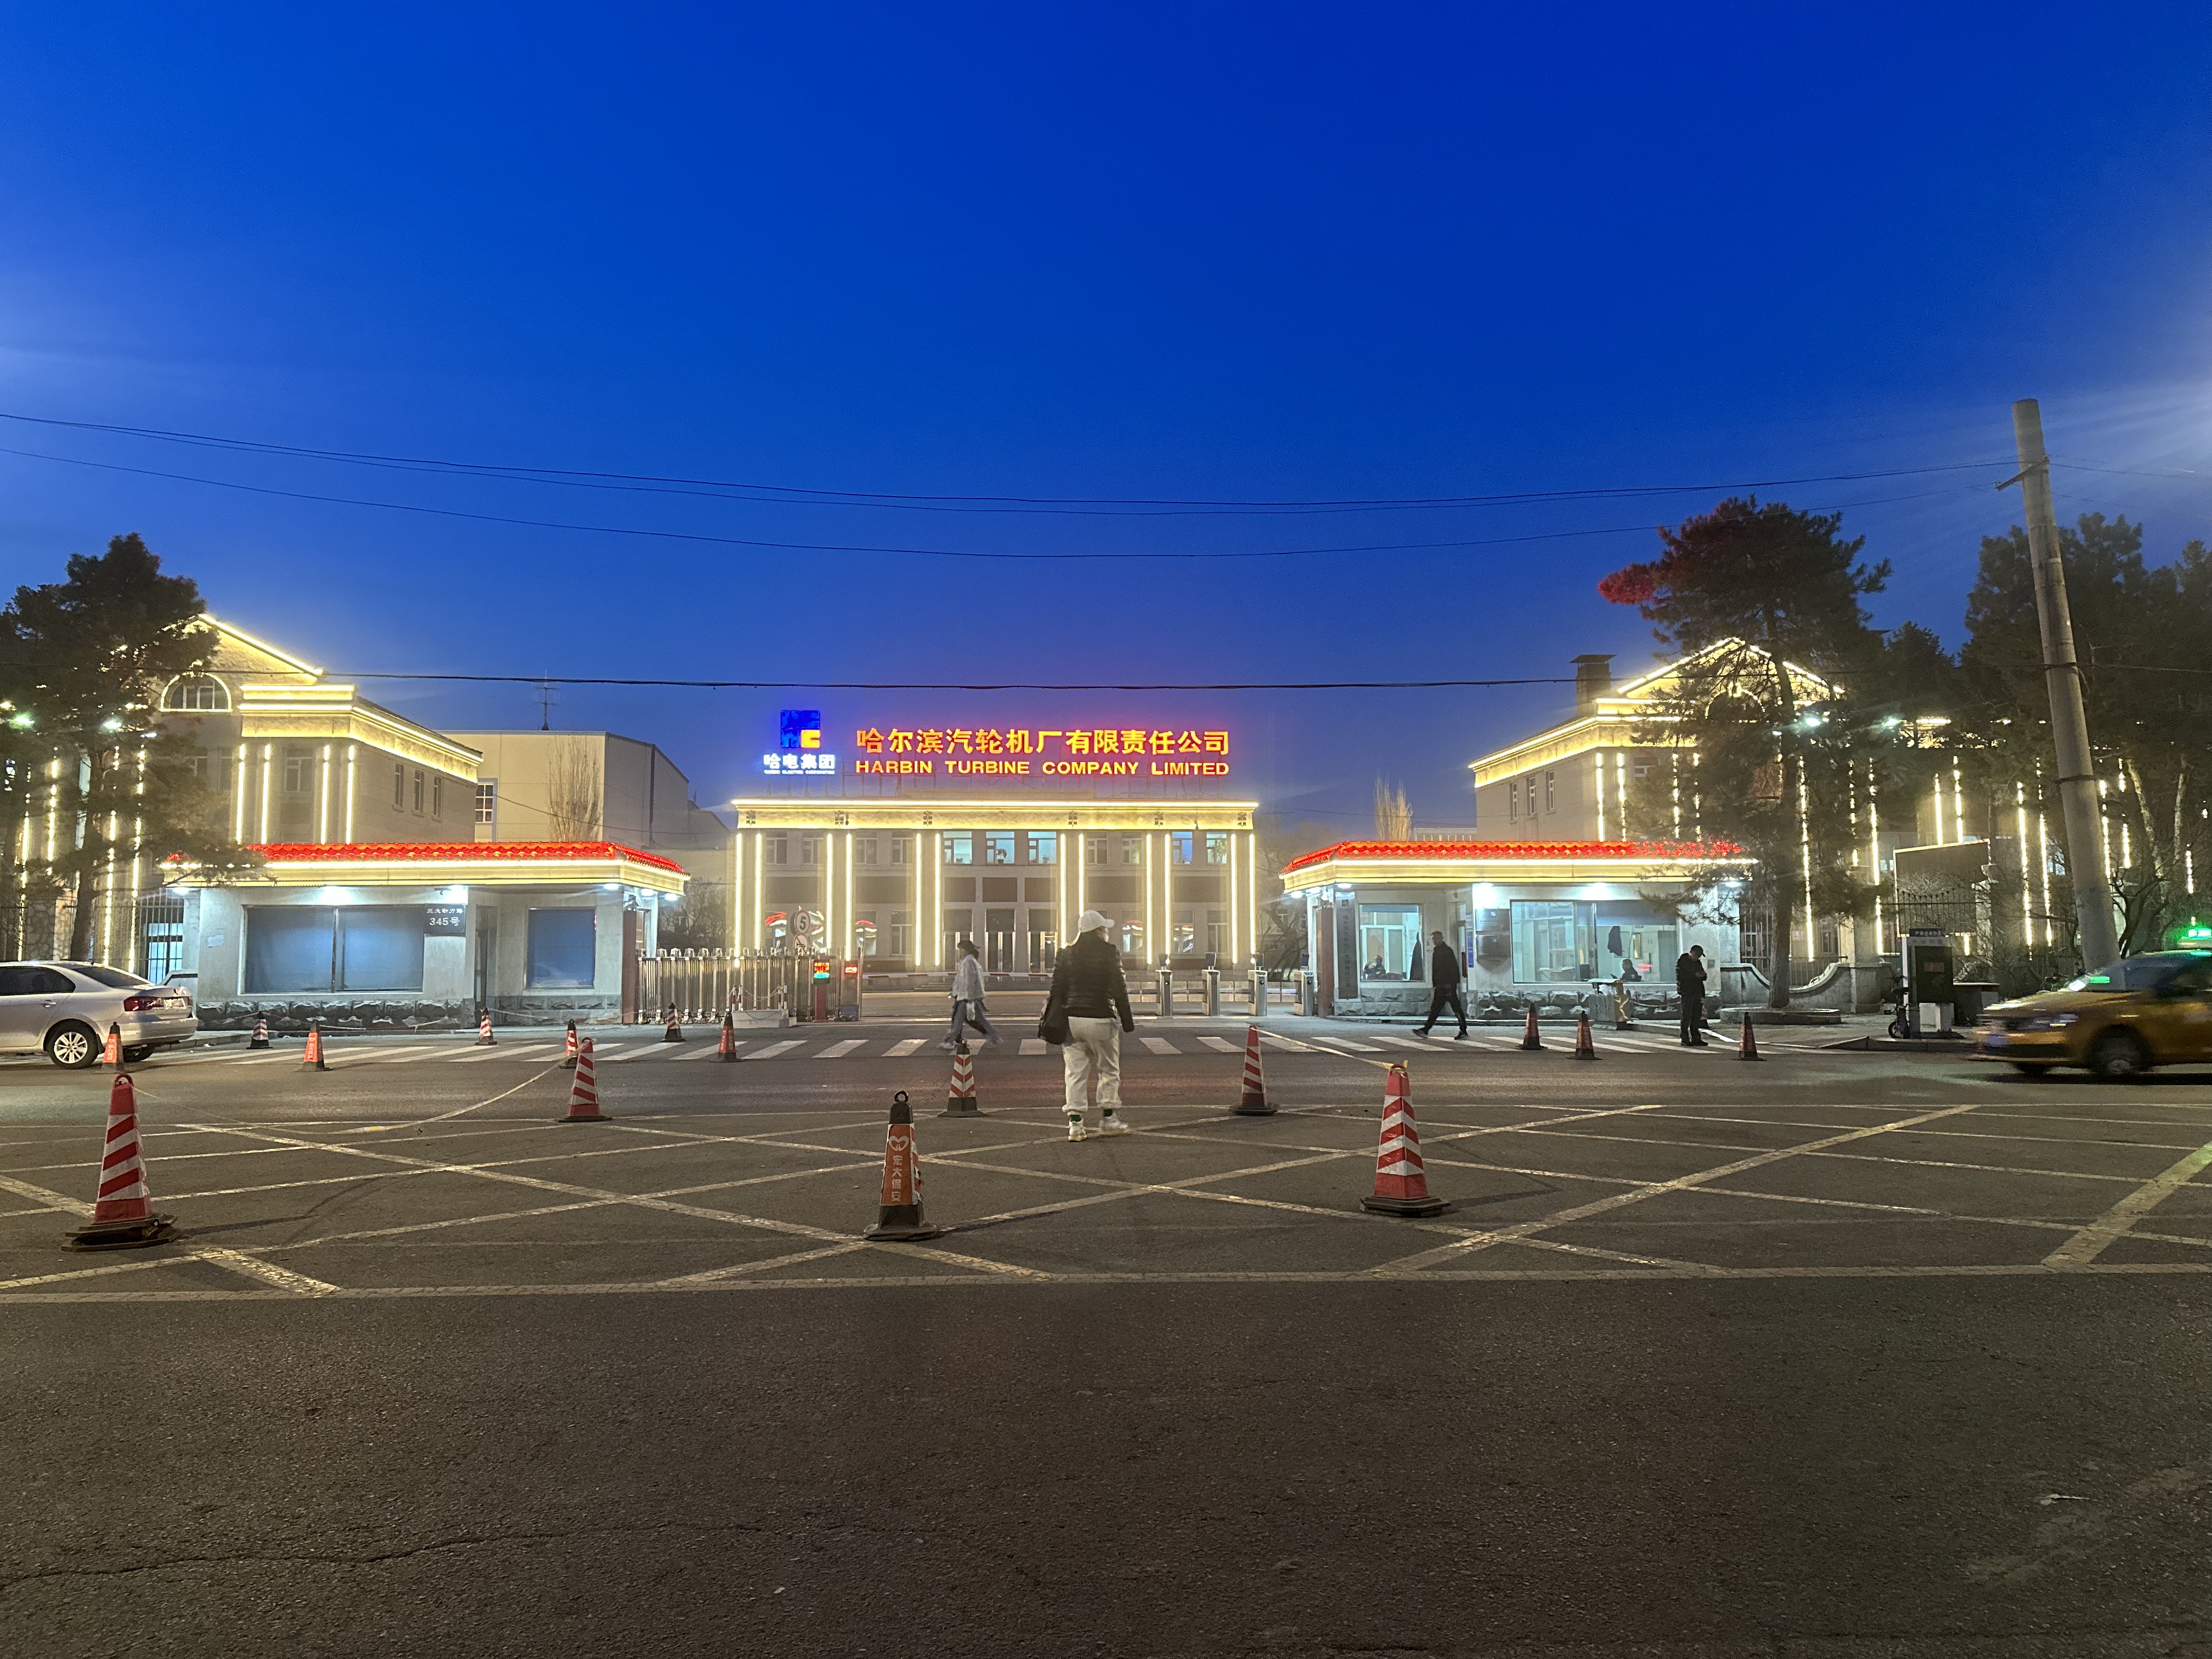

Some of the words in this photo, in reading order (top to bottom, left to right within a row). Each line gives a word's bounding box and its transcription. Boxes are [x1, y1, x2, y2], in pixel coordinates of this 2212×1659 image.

[857, 728, 1229, 755] 哈尔滨汽轮机厂有限责任公司
[763, 753, 835, 769] 哈电集团
[855, 760, 933, 774] HARBIN
[944, 760, 1030, 774] TURBINE
[1042, 761, 1139, 775] COMPANY
[1151, 761, 1229, 776] LIMITED
[429, 917, 460, 926] 345号
[800, 916, 806, 930] 5
[891, 1155, 902, 1201] 宏大保安
